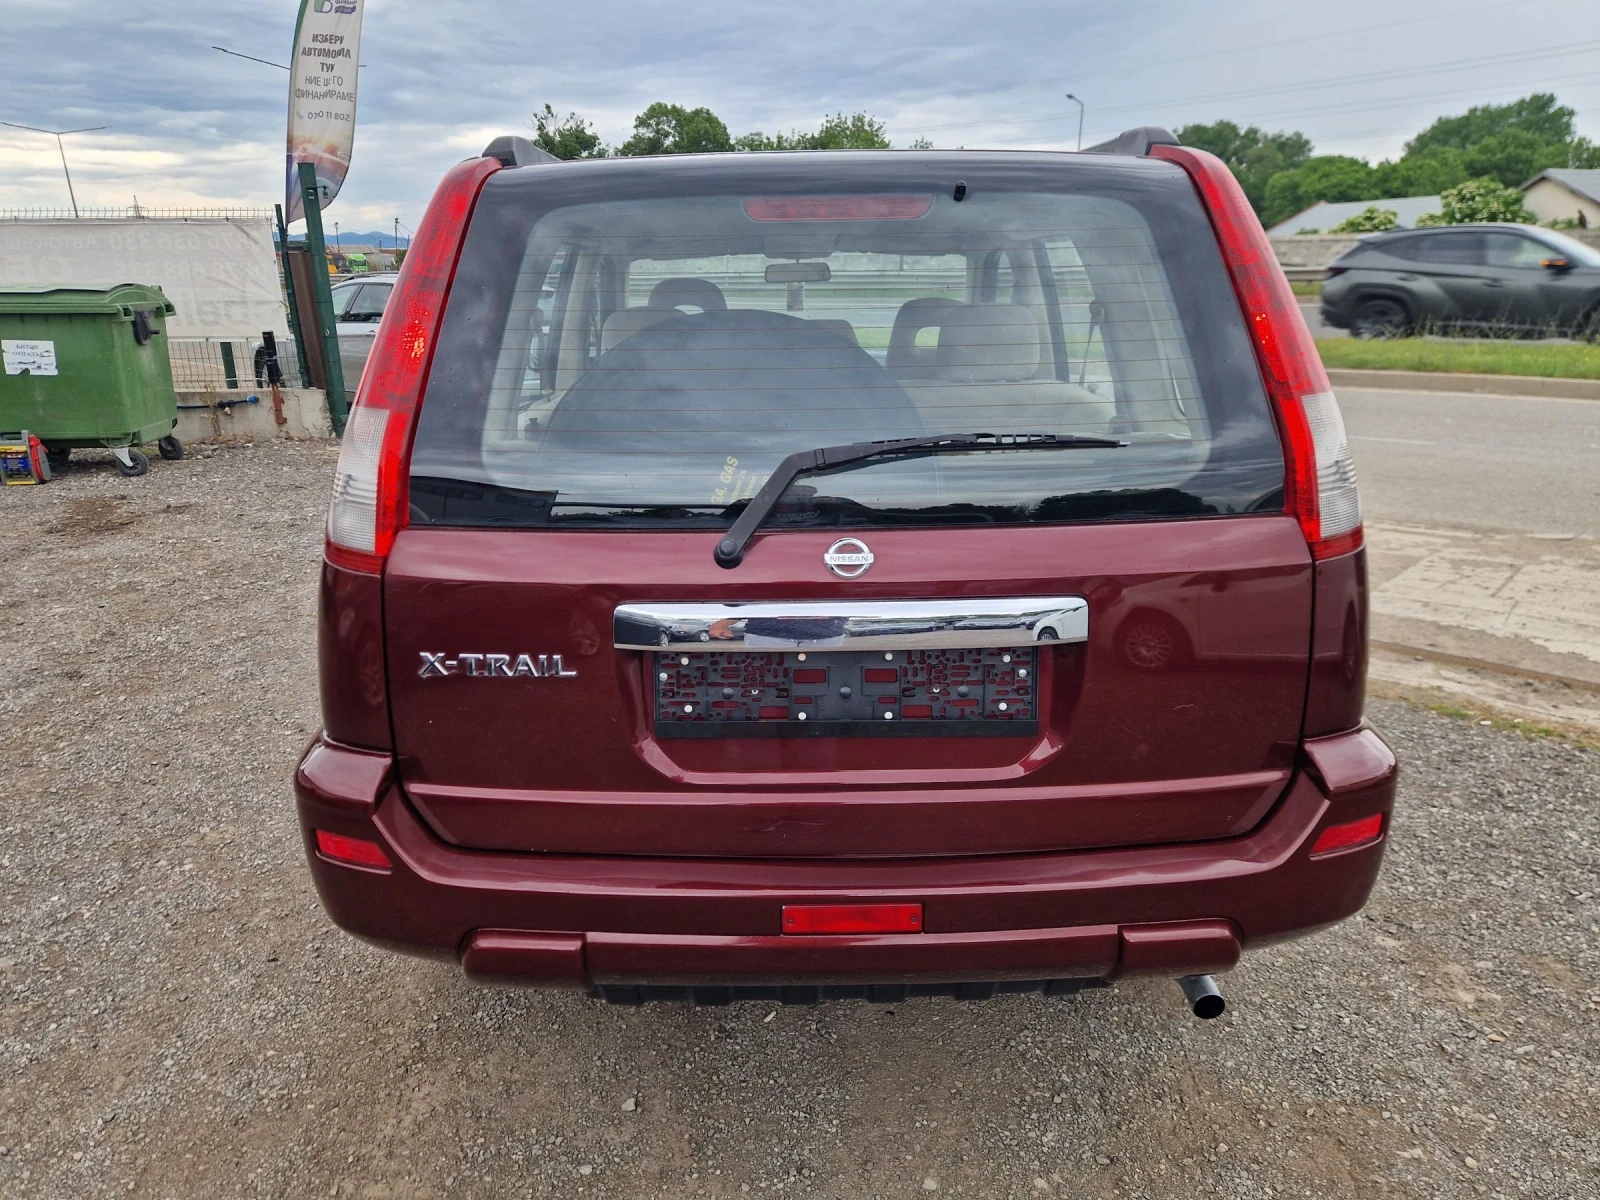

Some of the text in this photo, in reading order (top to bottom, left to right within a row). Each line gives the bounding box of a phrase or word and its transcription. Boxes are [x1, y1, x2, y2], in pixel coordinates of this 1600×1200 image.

[304, 75, 321, 87] НИЕ
[334, 112, 350, 122] 802
[720, 456, 738, 484] GAS
[418, 652, 577, 677] X-TRAIL
